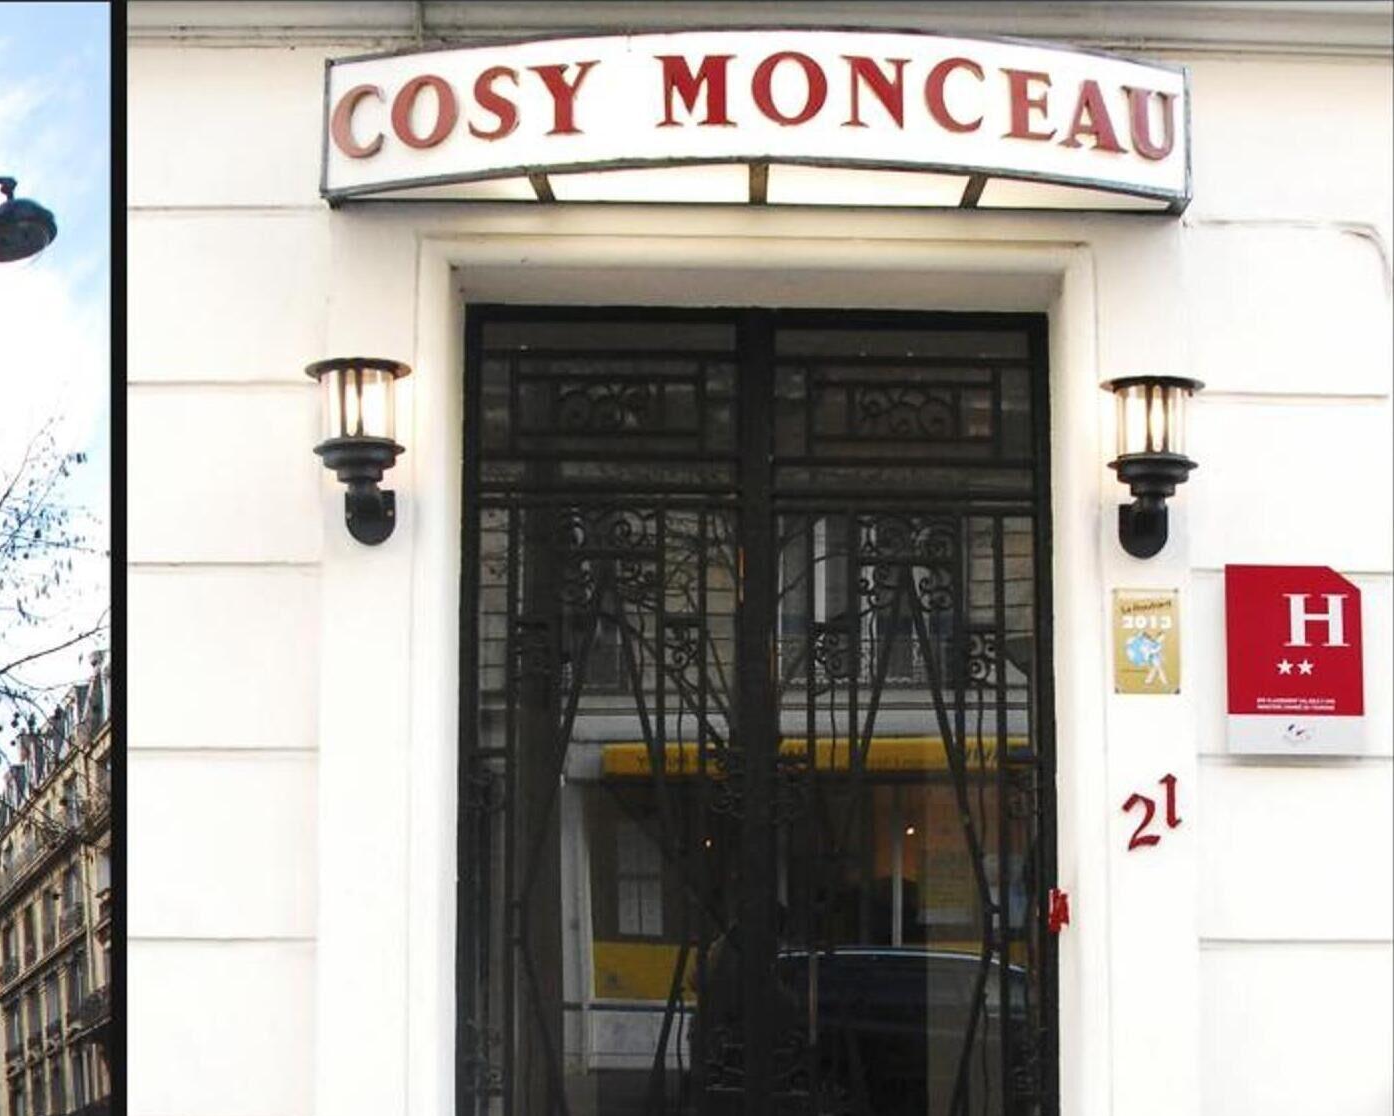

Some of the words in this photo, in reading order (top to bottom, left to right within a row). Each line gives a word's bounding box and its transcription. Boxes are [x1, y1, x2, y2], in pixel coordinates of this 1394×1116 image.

[331, 59, 601, 159] COSY
[654, 51, 1180, 161] MONCEAU
[1282, 593, 1350, 647] H
[1121, 772, 1183, 851] 21
